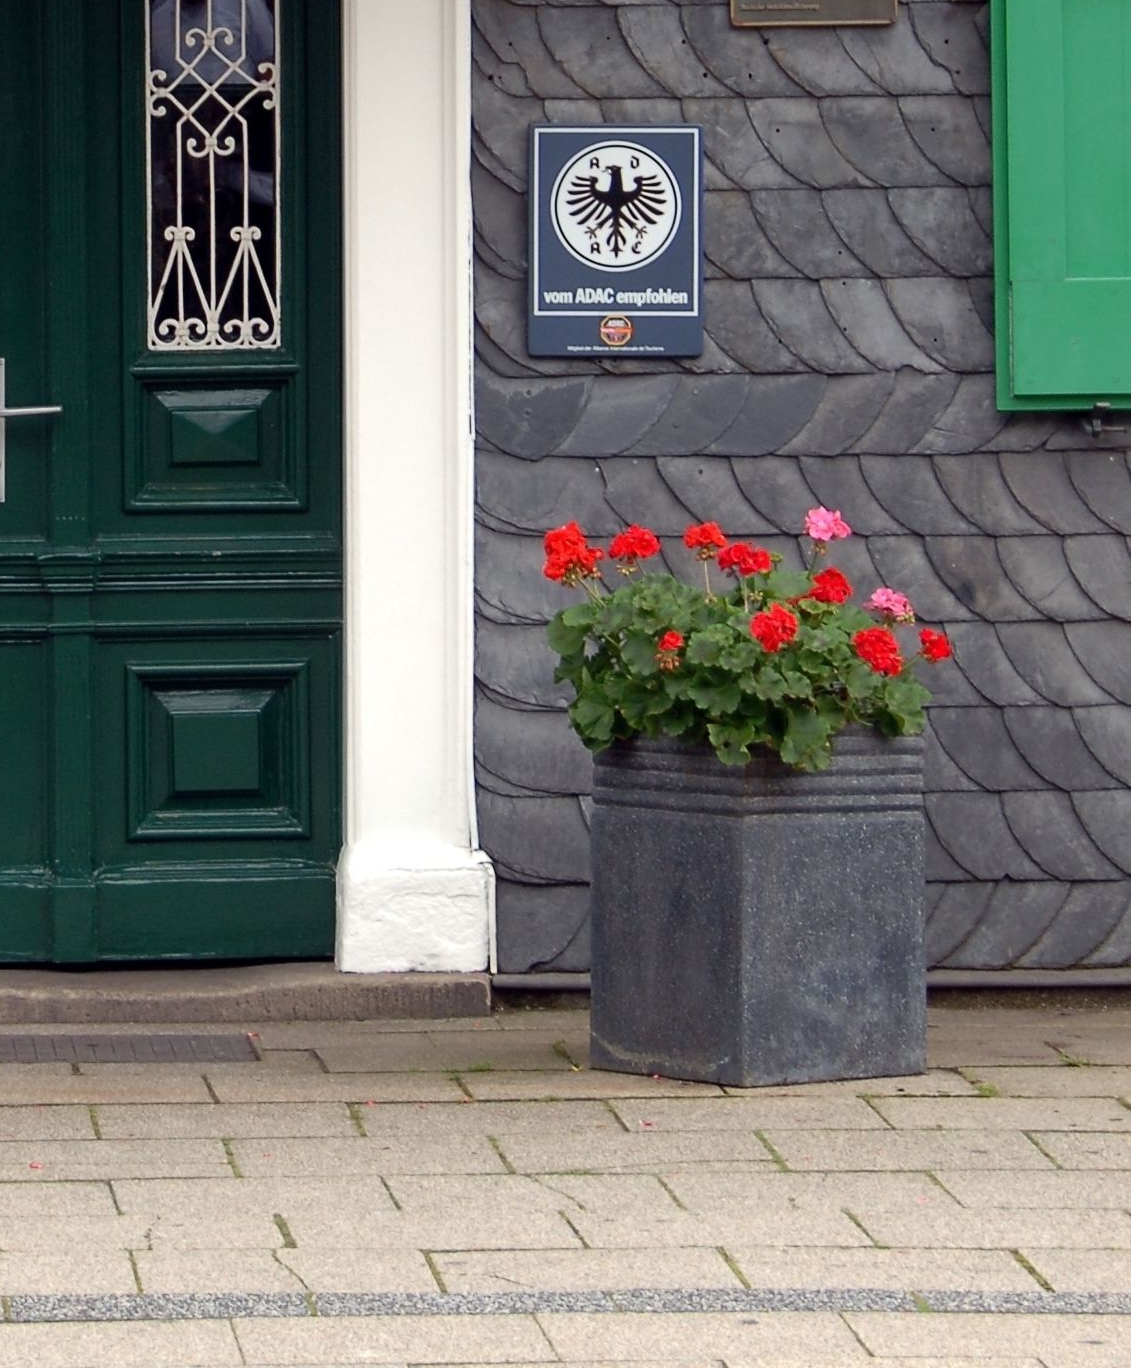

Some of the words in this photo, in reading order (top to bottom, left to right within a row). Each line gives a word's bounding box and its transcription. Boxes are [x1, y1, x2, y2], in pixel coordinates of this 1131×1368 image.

[544, 291, 573, 304] vom
[575, 288, 614, 304] ADAC
[616, 288, 689, 307] empfohlen
